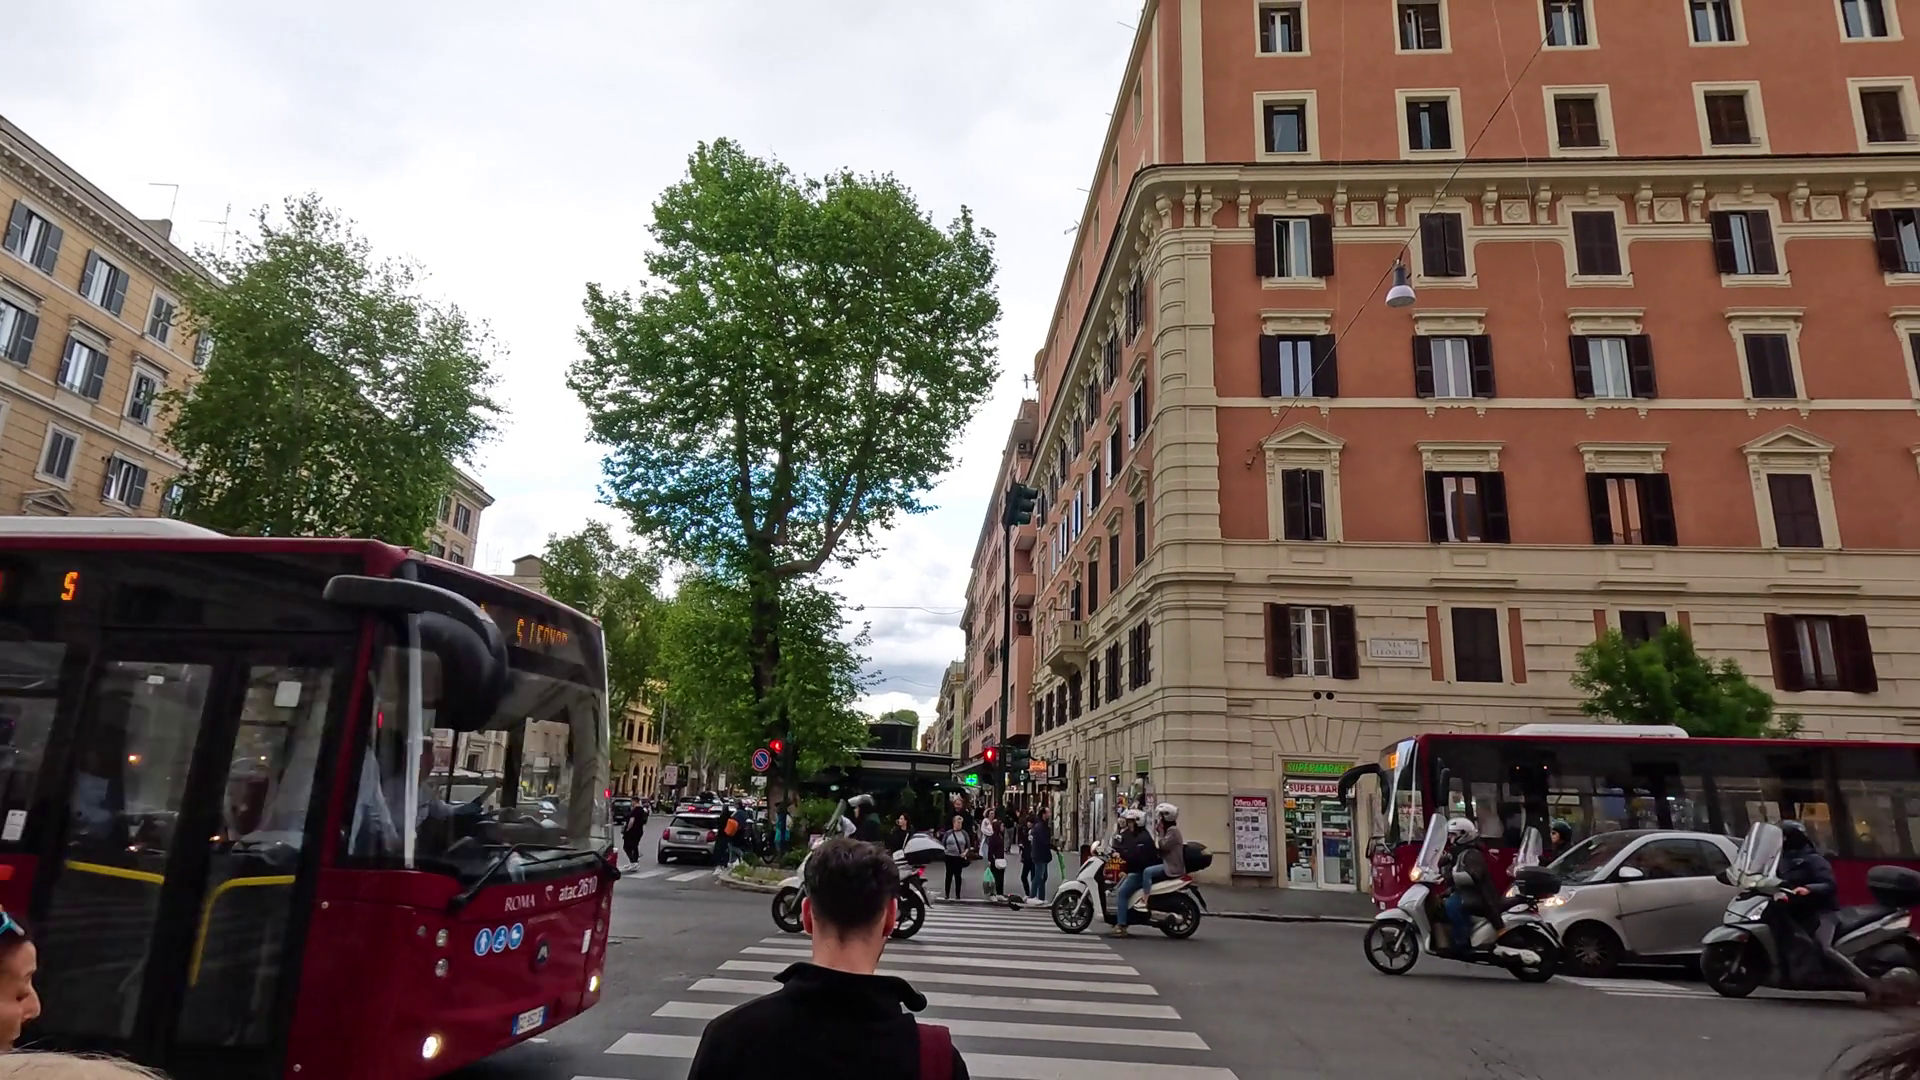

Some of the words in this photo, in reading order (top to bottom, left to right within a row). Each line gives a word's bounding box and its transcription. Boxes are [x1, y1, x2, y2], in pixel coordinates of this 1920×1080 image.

[1288, 762, 1350, 773] SUPERMARKE
[1289, 783, 1316, 793] SUPER
[504, 894, 536, 912] ROMA
